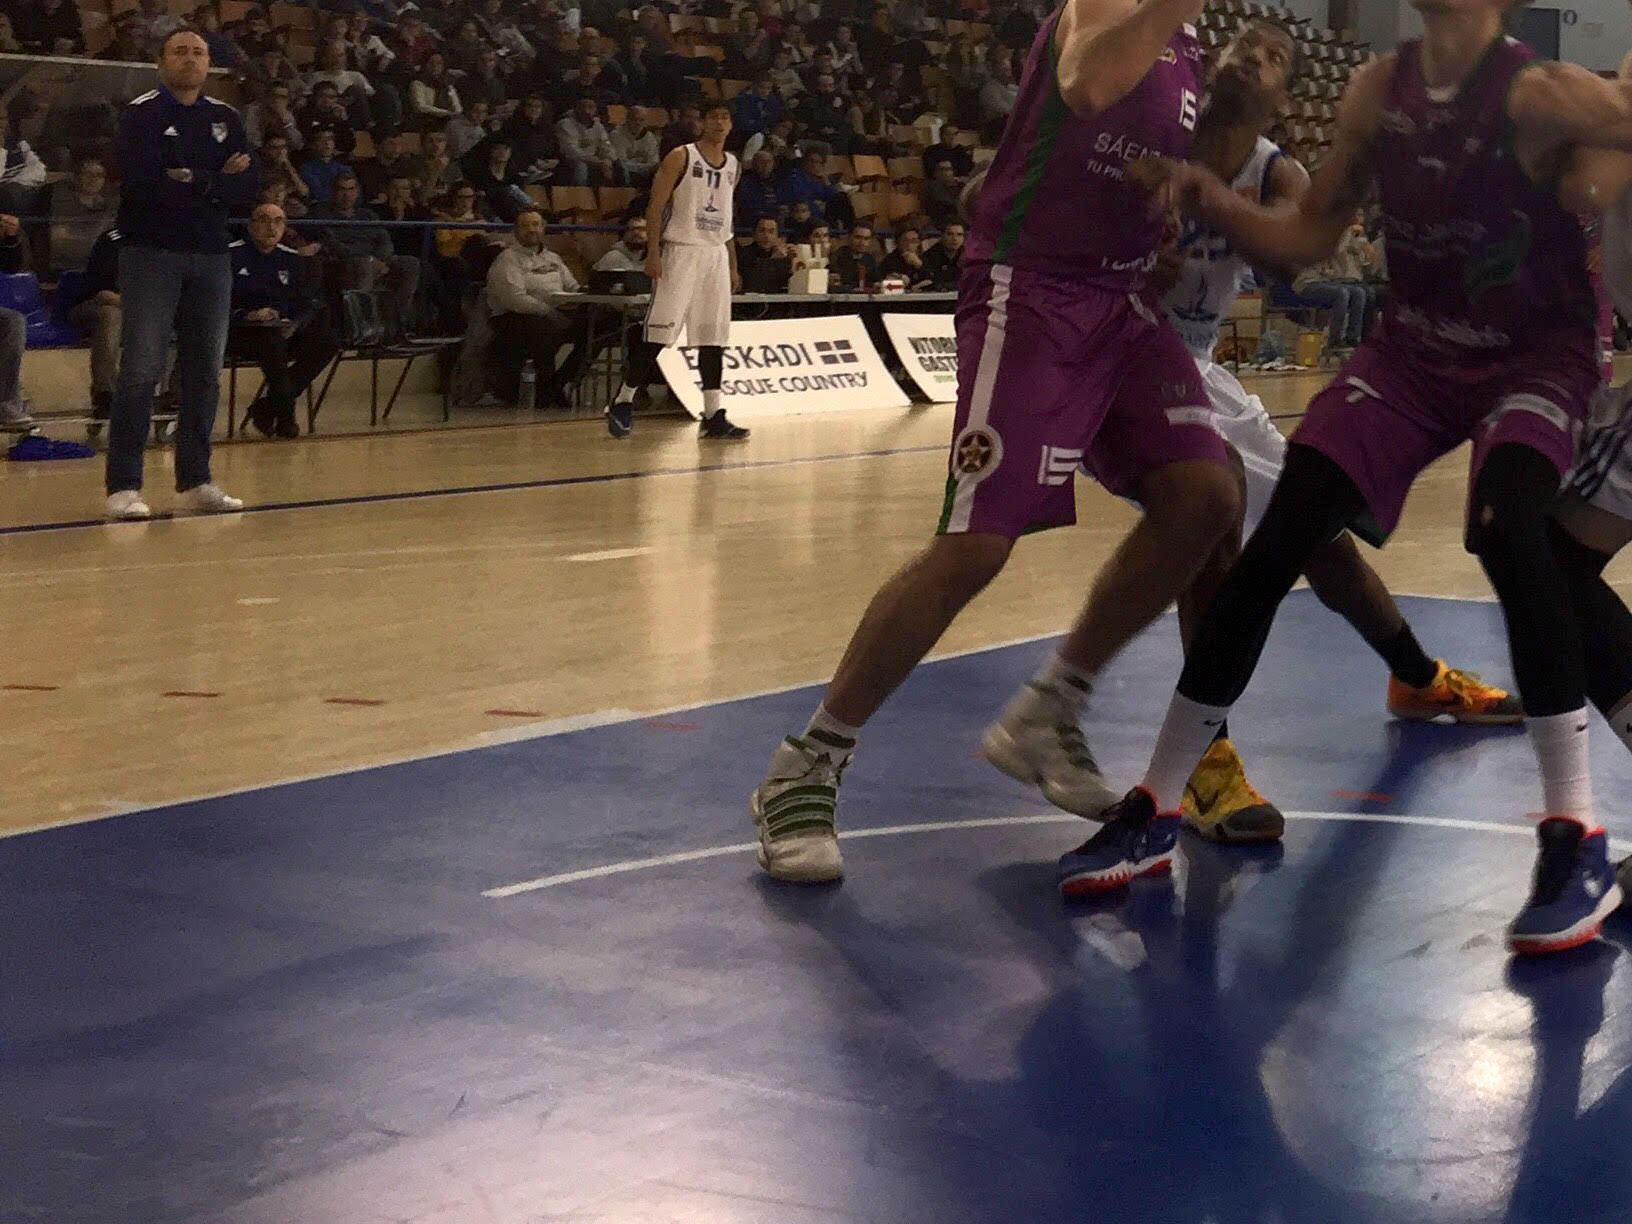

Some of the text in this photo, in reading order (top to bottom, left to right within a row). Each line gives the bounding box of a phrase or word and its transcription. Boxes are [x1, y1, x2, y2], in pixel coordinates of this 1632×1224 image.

[678, 343, 813, 370] ESKADI
[694, 371, 867, 396] SQUE COUNTRY
